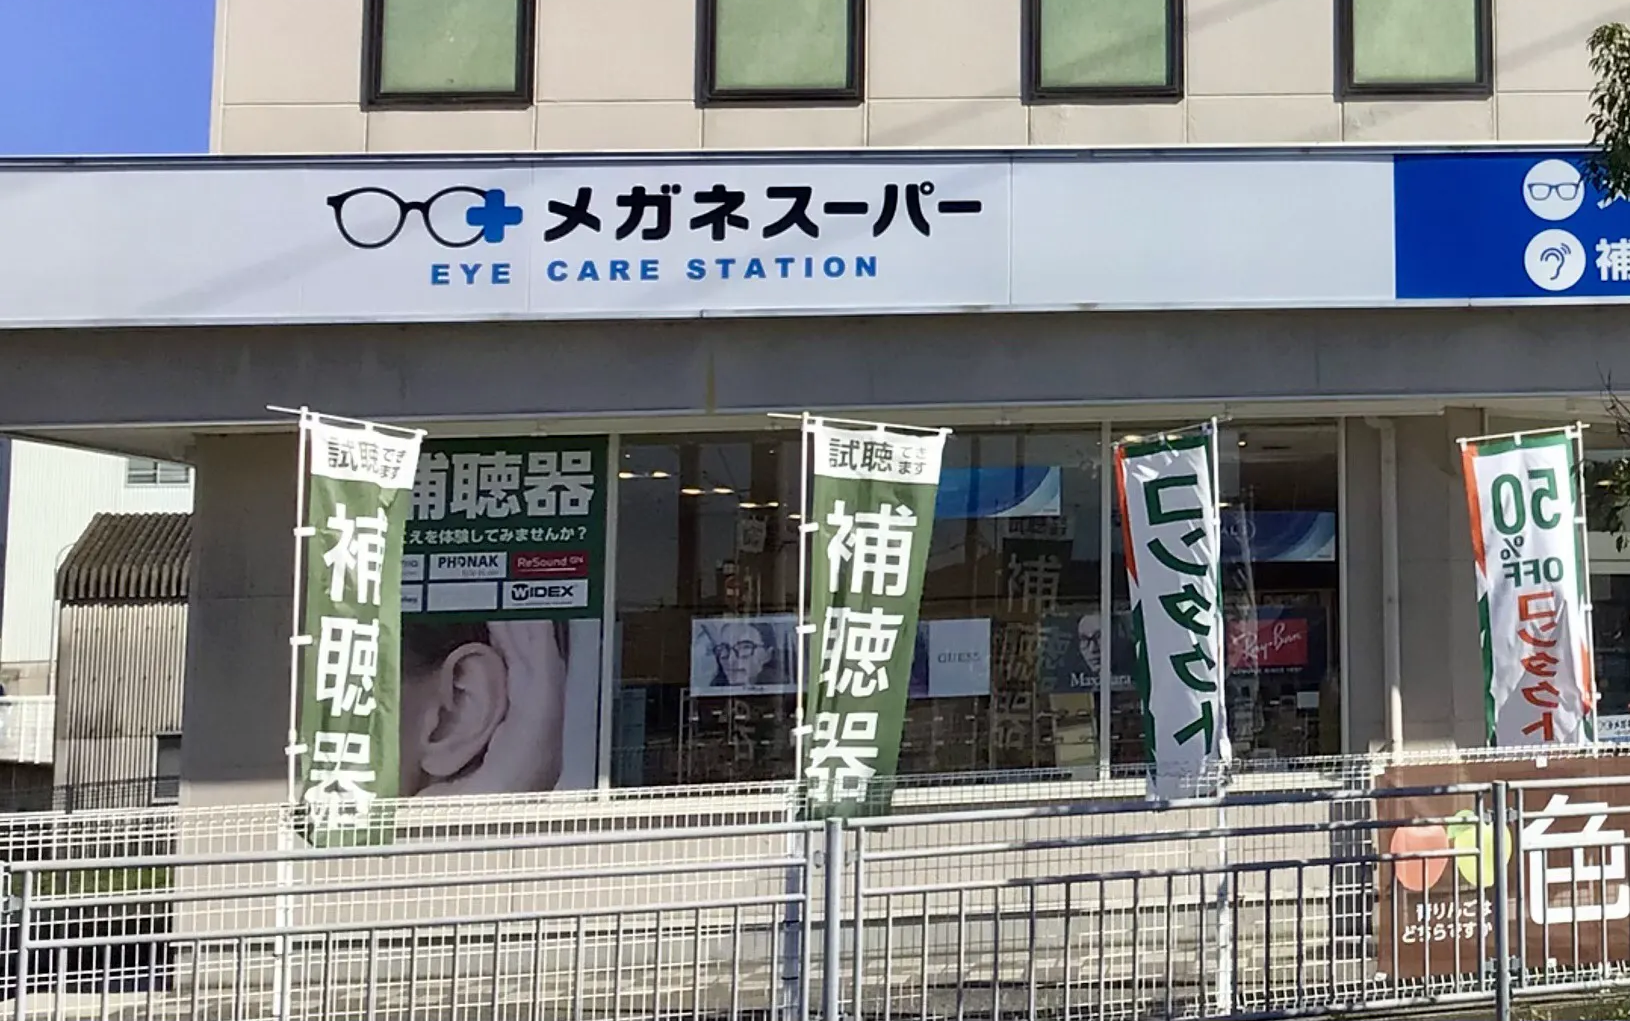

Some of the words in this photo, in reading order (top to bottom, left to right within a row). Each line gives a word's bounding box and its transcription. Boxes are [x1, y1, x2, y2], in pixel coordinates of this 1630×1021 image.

[543, 182, 982, 242] メガネスーパー
[431, 262, 512, 286] EYE
[547, 259, 660, 283] CARE
[686, 255, 879, 279] STATION
[438, 555, 499, 569] PHONAK
[517, 556, 567, 568] ReSound
[511, 583, 574, 601] WIDEX
[804, 499, 918, 803] 補聴器
[1231, 622, 1303, 661] Ray-Ban
[304, 503, 389, 830] 補聴器
